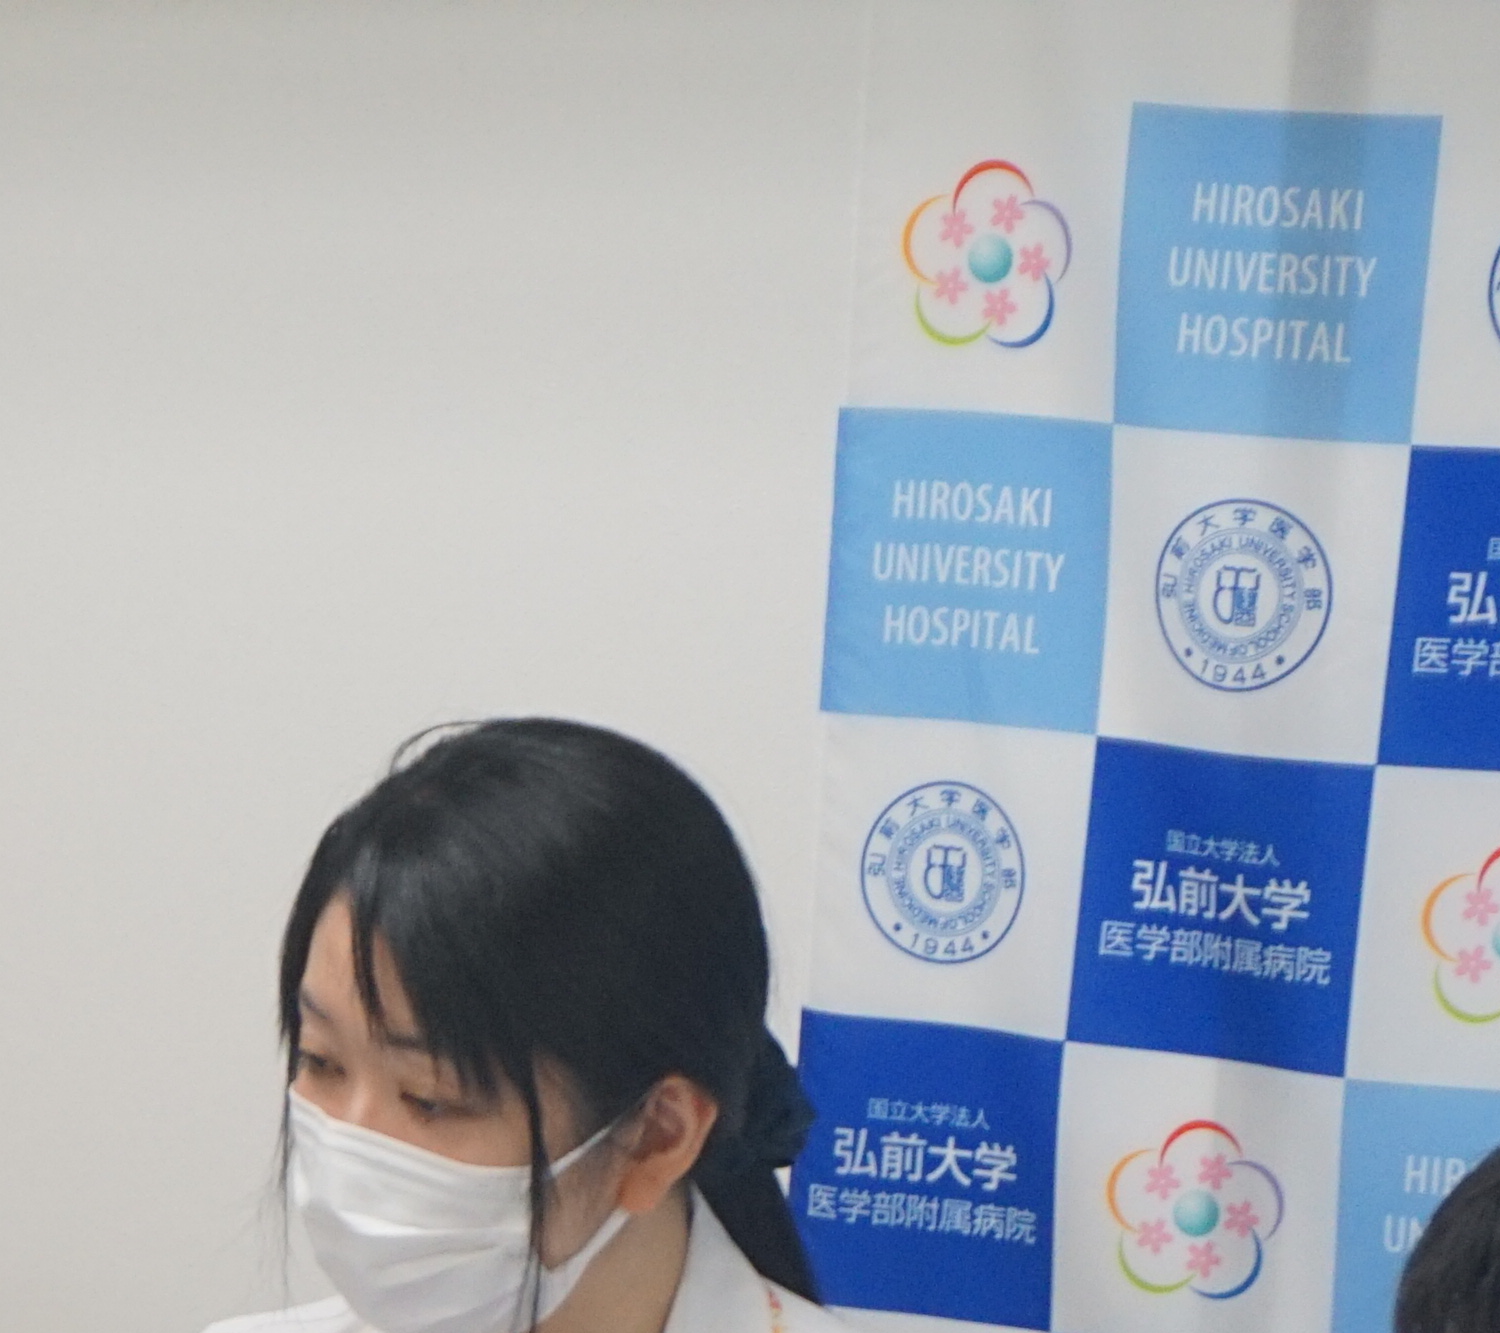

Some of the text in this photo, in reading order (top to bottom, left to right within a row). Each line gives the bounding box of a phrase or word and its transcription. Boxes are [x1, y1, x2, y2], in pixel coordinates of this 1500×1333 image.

[1192, 182, 1364, 231] HIROSAKI
[1168, 246, 1378, 298] UNIVERSITY
[1176, 312, 1351, 364] HOSPITAL
[892, 479, 1053, 528] HIROSAKI
[872, 541, 1066, 593] UNIVERSITY
[882, 605, 1040, 656] HOSPITAL
[1198, 660, 1268, 682] 1944
[1166, 829, 1281, 867] 国立大学法人
[1131, 859, 1312, 930] 弘前大学
[910, 934, 973, 956] 1944
[1098, 920, 1332, 986] 医学部附属病院
[867, 1097, 990, 1130] 国立大学法人
[833, 1127, 1017, 1191] 弘前大学
[806, 1183, 1036, 1245] 医学部附属病院
